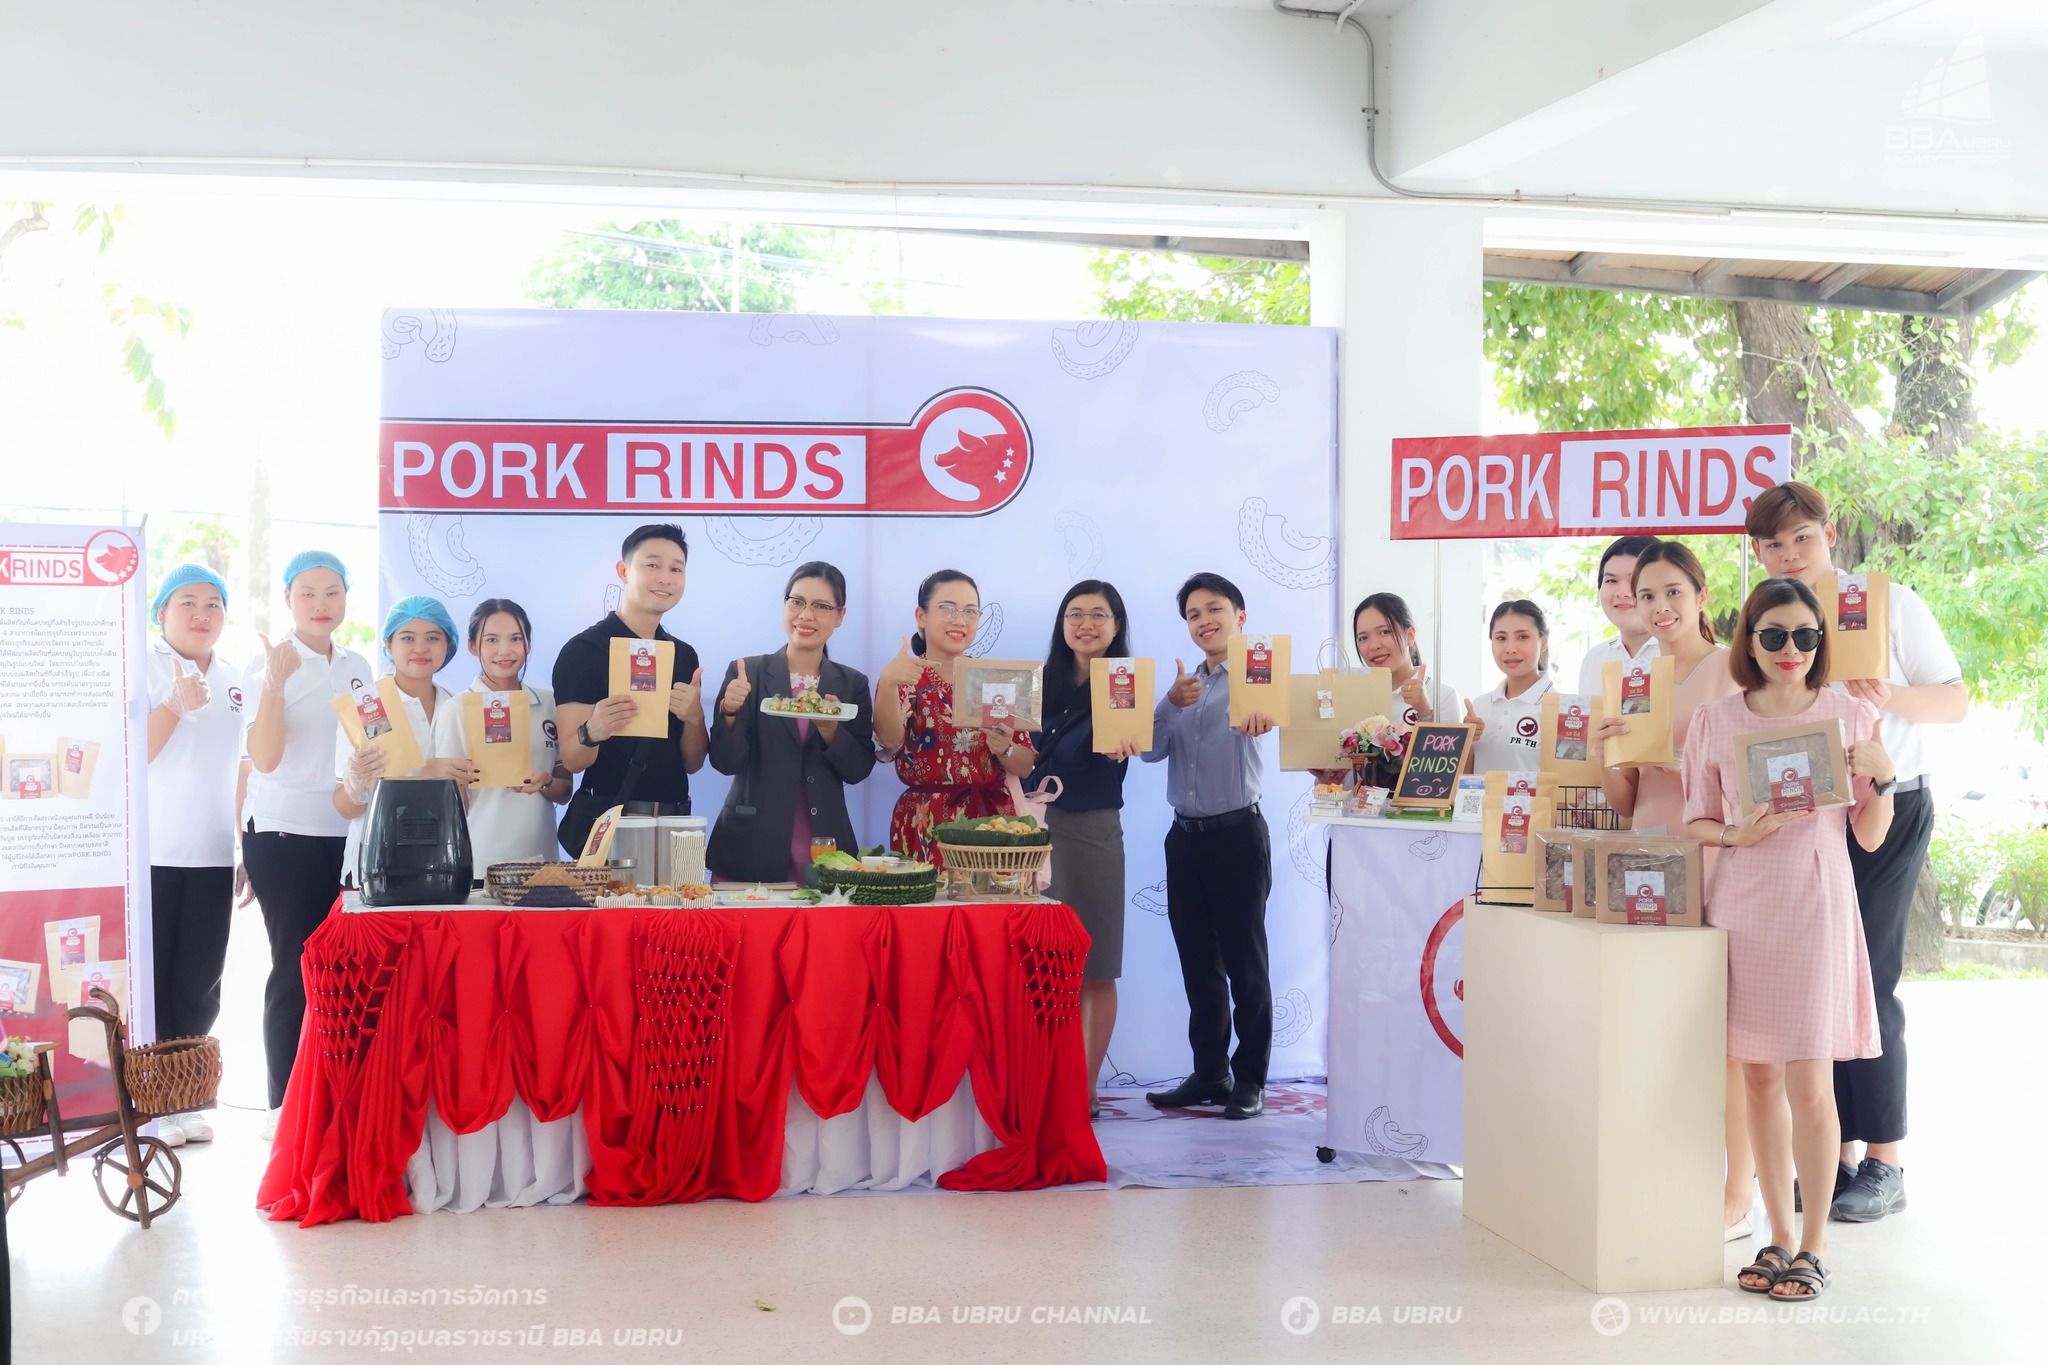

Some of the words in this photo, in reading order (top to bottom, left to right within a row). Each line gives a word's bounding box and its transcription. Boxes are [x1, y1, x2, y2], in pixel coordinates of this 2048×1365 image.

[393, 441, 585, 499] PORK
[625, 442, 844, 500] RINDS
[1401, 453, 1554, 523] PORK
[1593, 446, 1777, 517] RINDS
[12, 559, 82, 578] RINDS
[9, 607, 35, 615] RINDS
[1422, 734, 1460, 752] PORK
[1525, 739, 1537, 748] TH
[1407, 756, 1459, 774] RINDS
